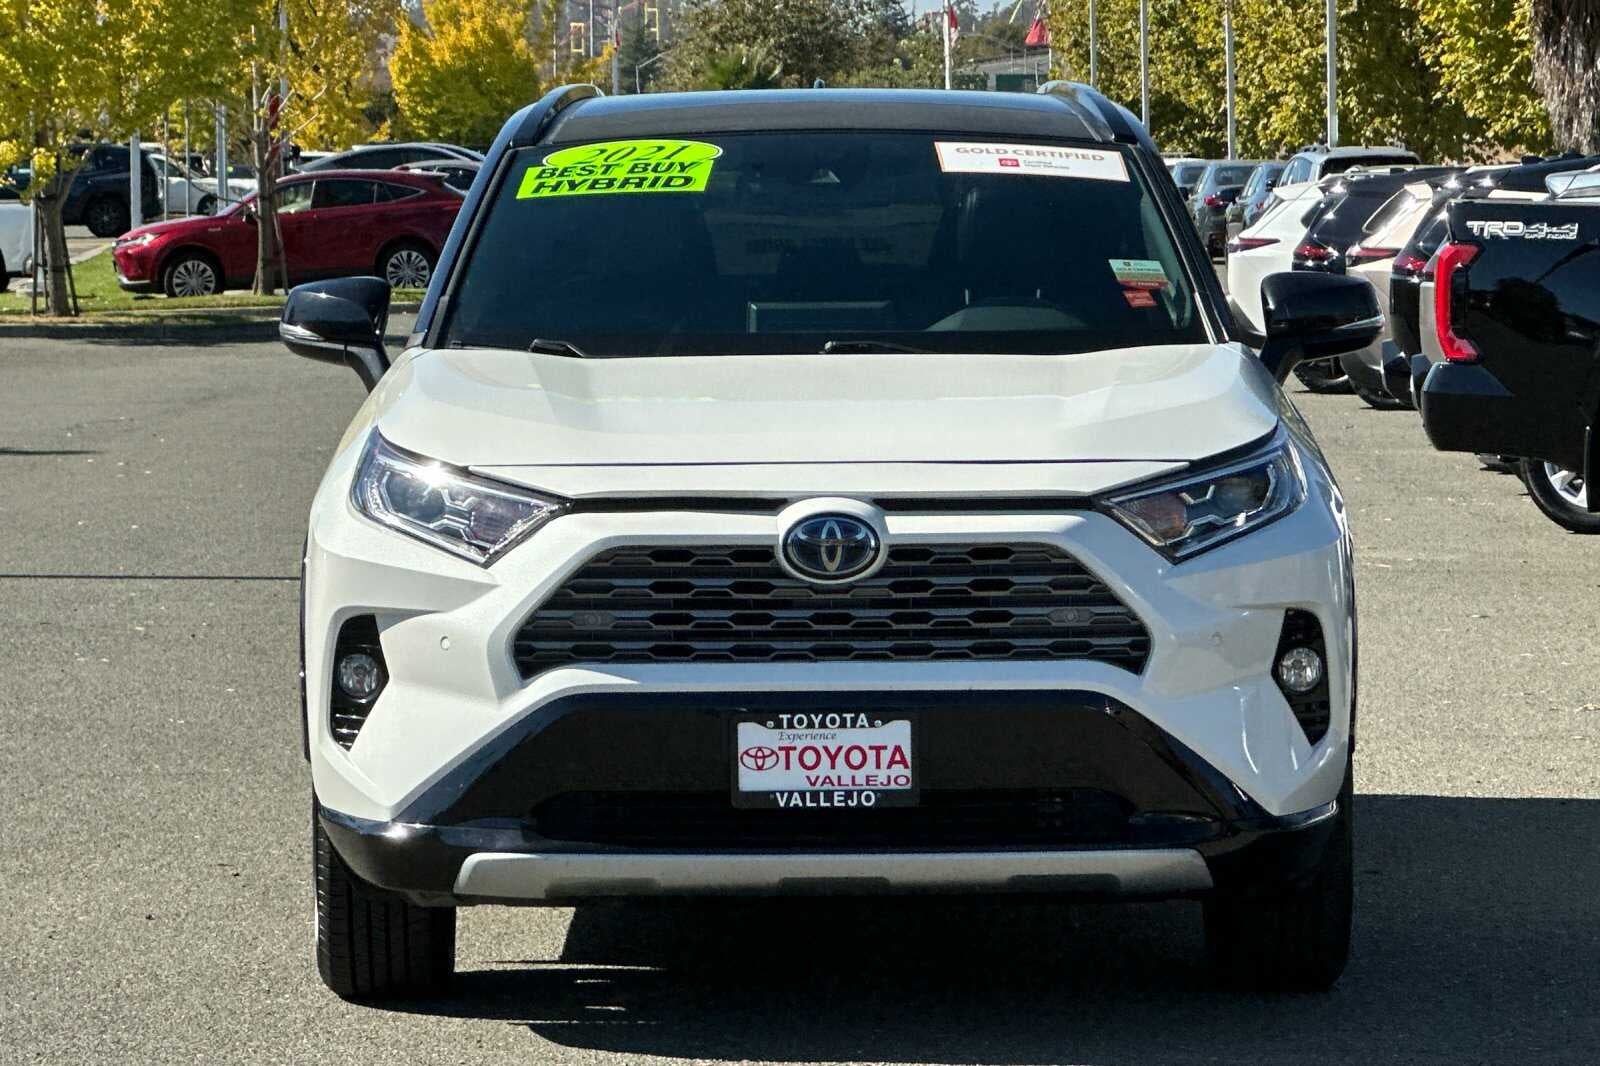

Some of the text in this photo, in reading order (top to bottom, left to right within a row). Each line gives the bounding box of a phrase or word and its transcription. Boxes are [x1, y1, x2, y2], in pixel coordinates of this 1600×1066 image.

[574, 145, 689, 164] 2021
[956, 147, 1105, 161] GOLD CERTIFIED
[535, 161, 700, 180] BEST BUY
[532, 175, 696, 194] HYBRID
[1466, 221, 1526, 239] TRD
[779, 713, 869, 729] TOYOTA
[778, 731, 837, 743] Experience
[778, 745, 910, 771] TOYOTA
[805, 775, 911, 787] VALLEJO
[776, 791, 875, 807] VALLEJO
